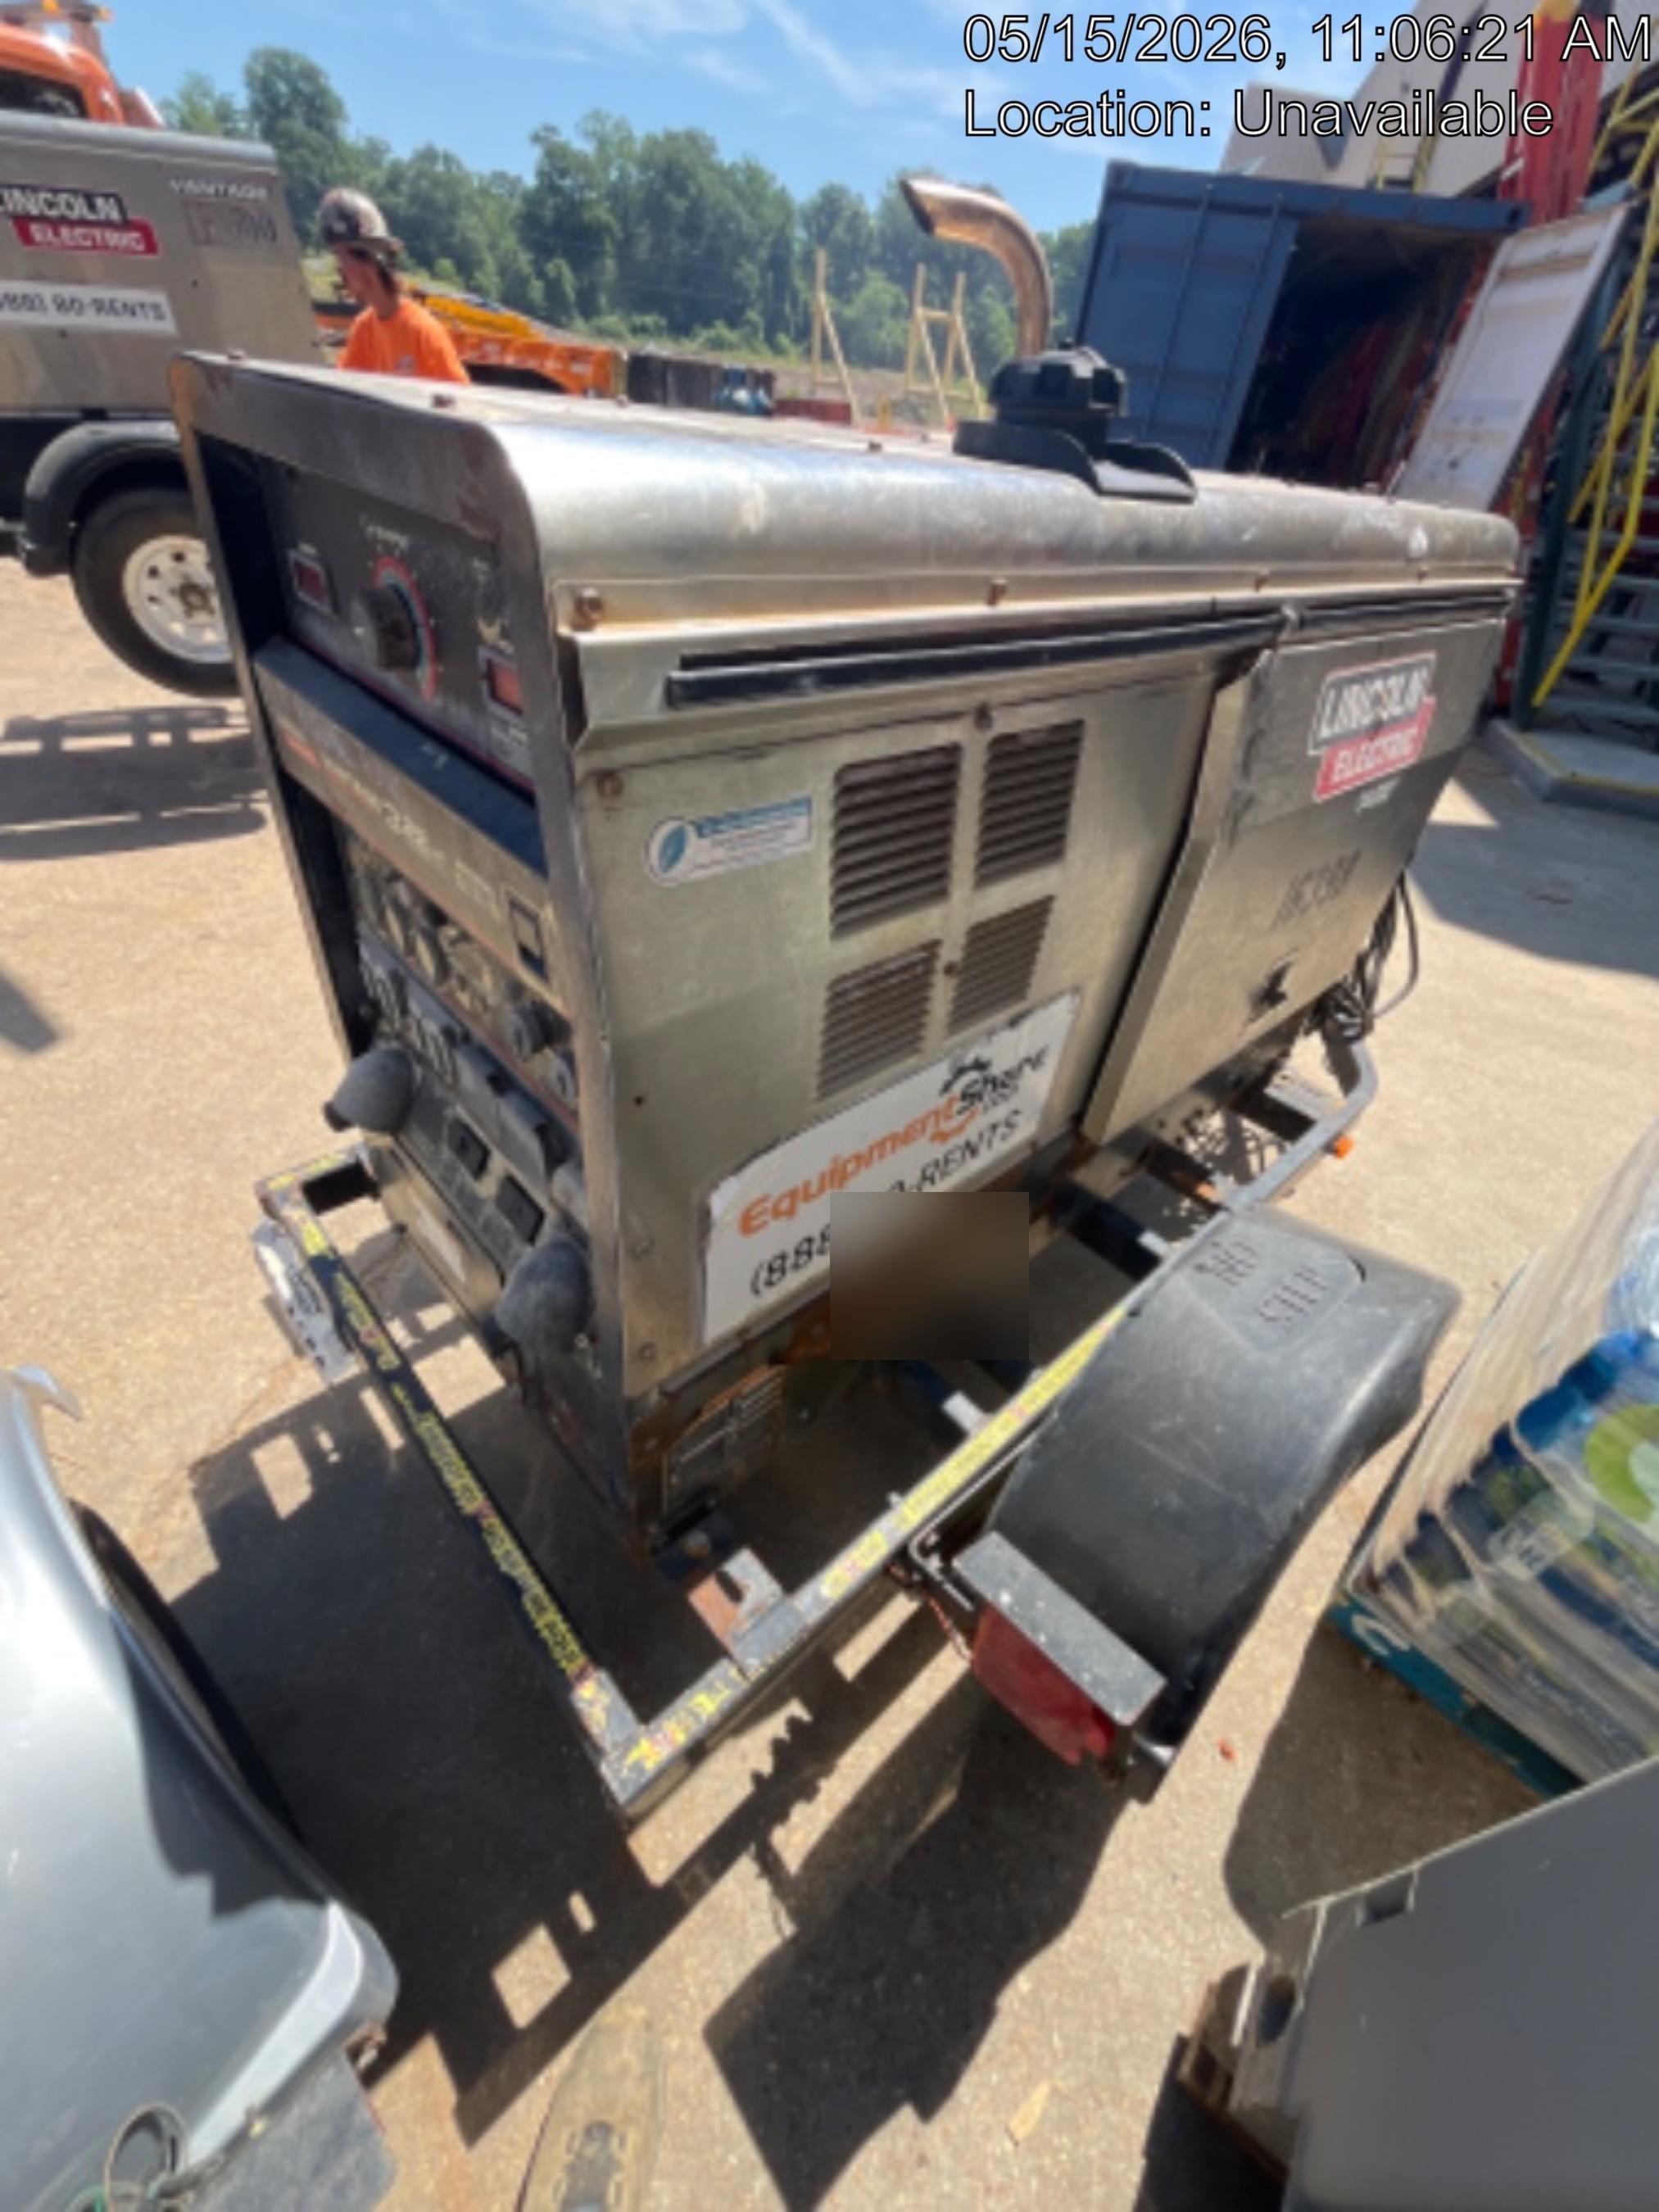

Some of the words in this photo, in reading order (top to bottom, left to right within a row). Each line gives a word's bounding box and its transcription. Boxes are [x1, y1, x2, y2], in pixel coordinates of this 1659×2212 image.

[0, 188, 123, 223] INCOLN
[29, 222, 145, 252] ELECTRIC
[1317, 666, 1430, 740] LINCOLN
[1329, 727, 1419, 784] ELECTRIC
